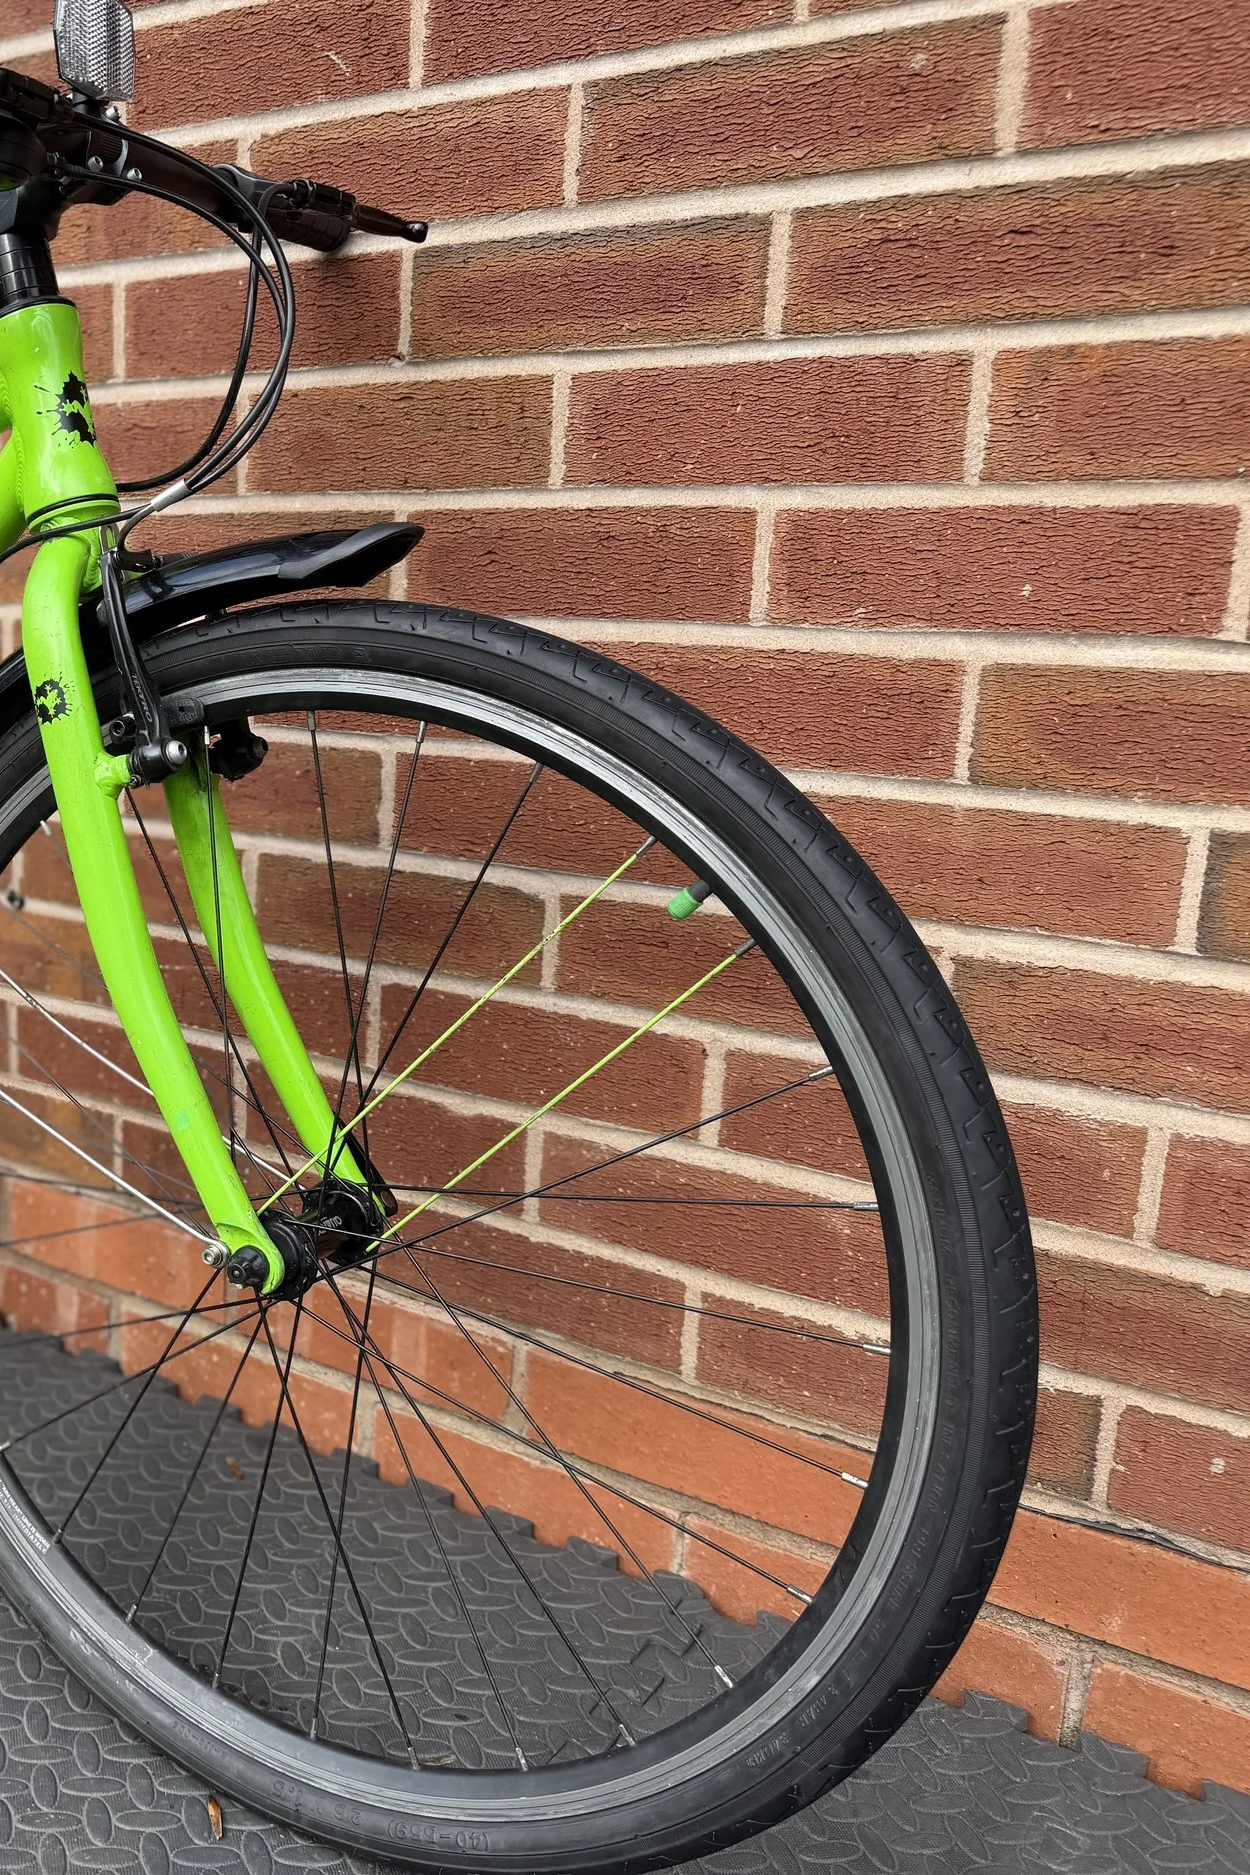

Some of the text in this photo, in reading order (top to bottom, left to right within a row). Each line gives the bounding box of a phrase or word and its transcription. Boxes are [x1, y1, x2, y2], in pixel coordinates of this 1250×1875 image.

[244, 646, 374, 667] KENDA
[131, 673, 153, 723] TEKTRO
[269, 1778, 304, 1809] 1.5
[333, 1802, 364, 1827] 26
[386, 1818, 490, 1852] (40-559)
